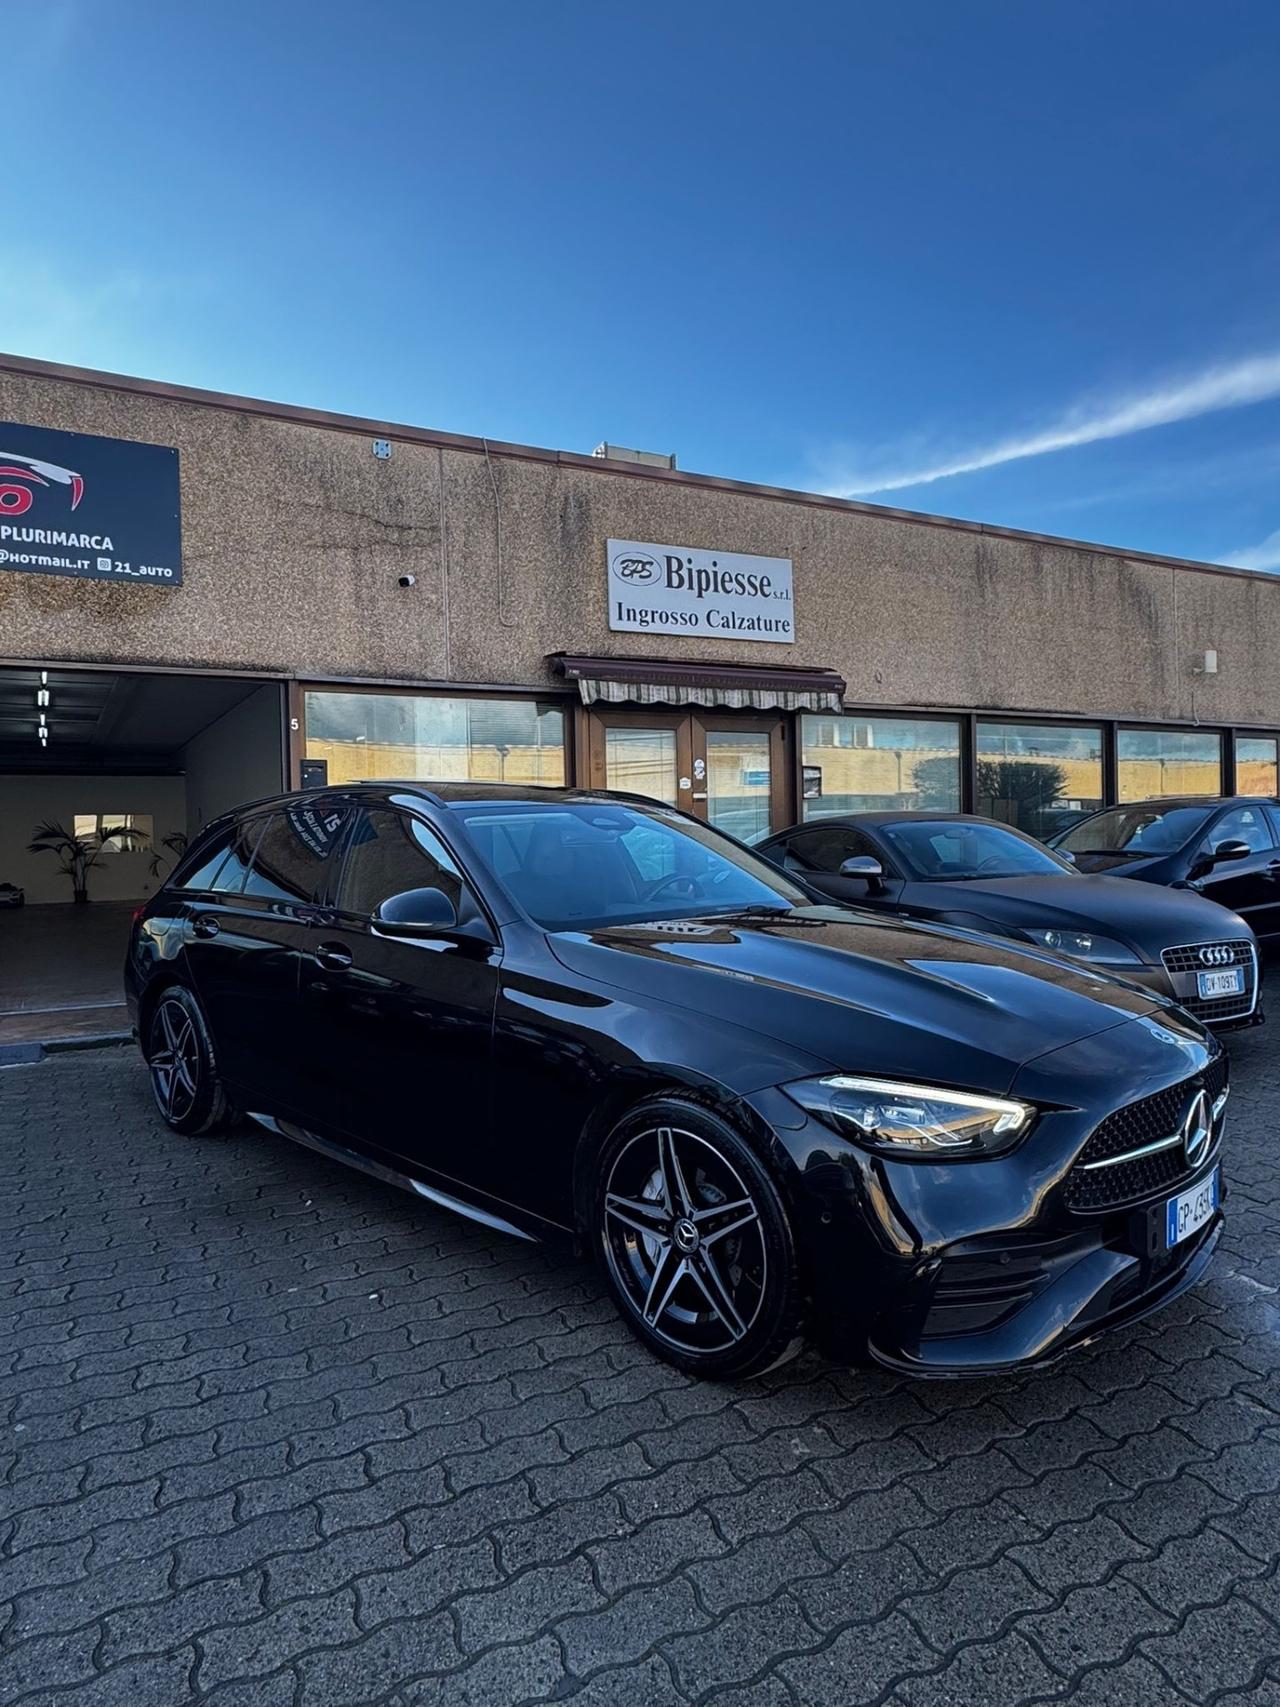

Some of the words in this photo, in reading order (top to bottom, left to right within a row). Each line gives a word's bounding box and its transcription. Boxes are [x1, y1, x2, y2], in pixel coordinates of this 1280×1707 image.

[0, 525, 114, 551] PLURIMARCA
[663, 554, 771, 599] Bipiesse
[773, 588, 792, 601] s.r.l.
[616, 601, 699, 627] Ingrosso
[706, 609, 791, 633] Calzature
[290, 718, 299, 730] 5
